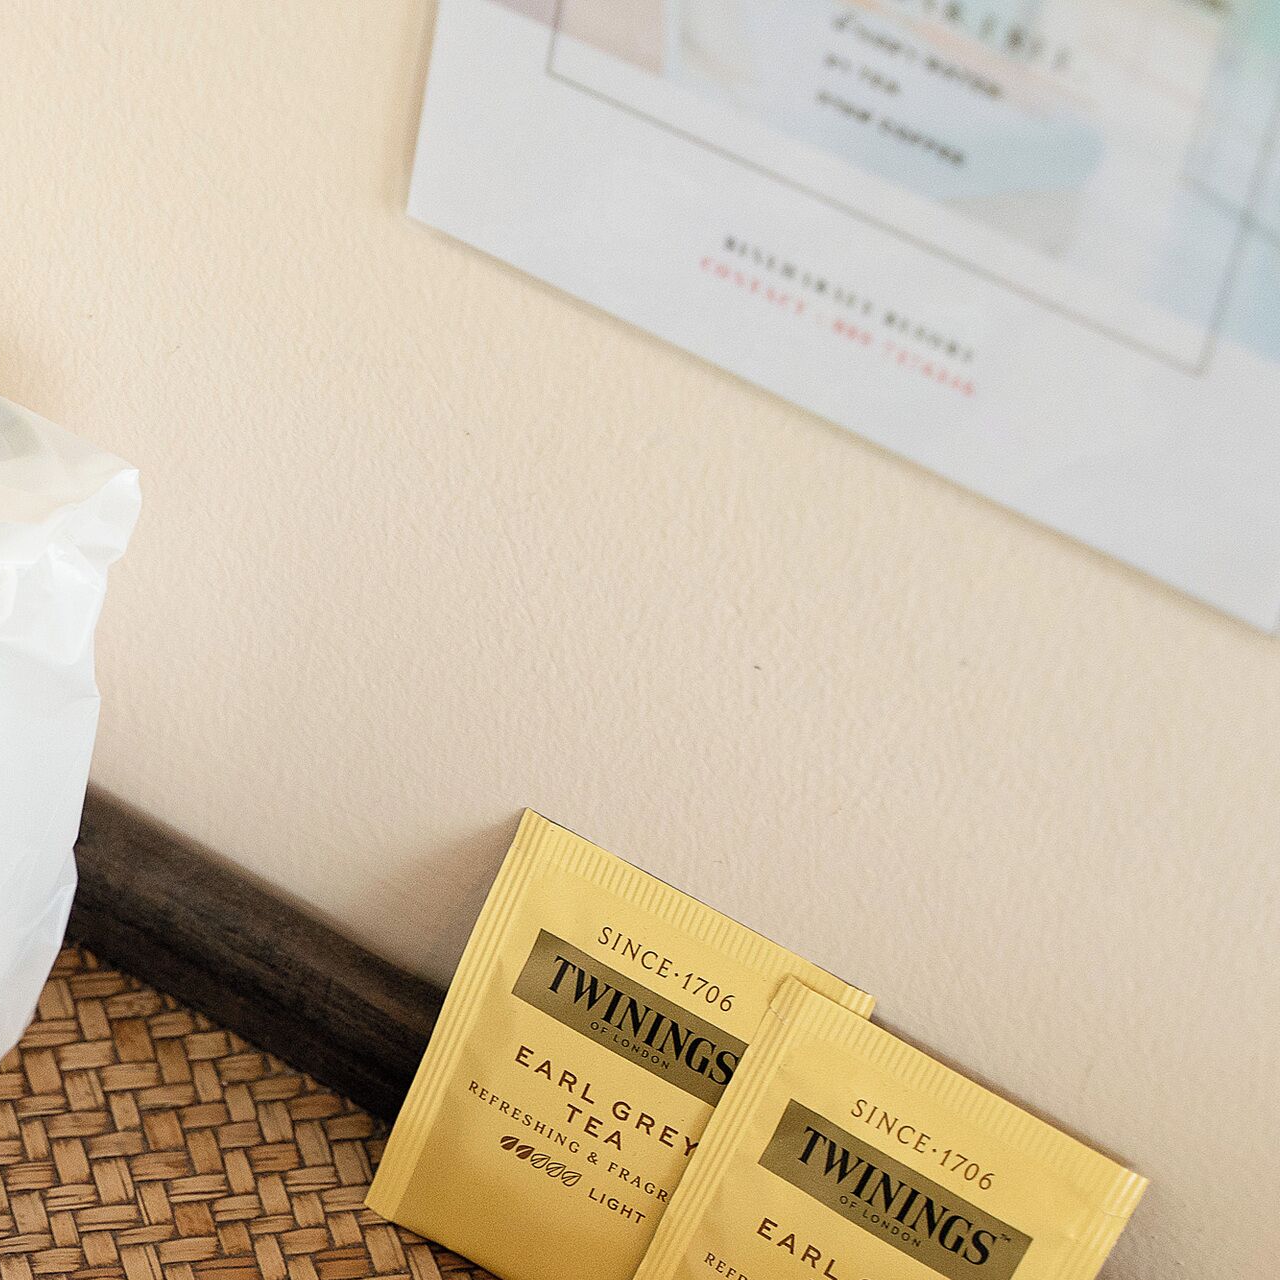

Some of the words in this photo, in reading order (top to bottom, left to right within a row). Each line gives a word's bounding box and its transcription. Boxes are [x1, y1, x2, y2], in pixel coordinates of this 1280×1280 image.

[548, 955, 739, 1086] TWININGS
[590, 1021, 609, 1035] OF
[613, 1033, 671, 1070] LONDON
[468, 1080, 581, 1153] REFRESHING
[587, 1151, 599, 1166] &
[607, 1161, 669, 1204] FRAGR
[514, 1045, 595, 1105] EARL
[612, 1101, 699, 1158] GREY
[566, 1103, 623, 1150] TEA
[588, 1187, 646, 1224] LIGHT
[797, 1125, 998, 1266] TWININGS
[839, 1194, 858, 1209] OF
[861, 1207, 922, 1248] LONDON
